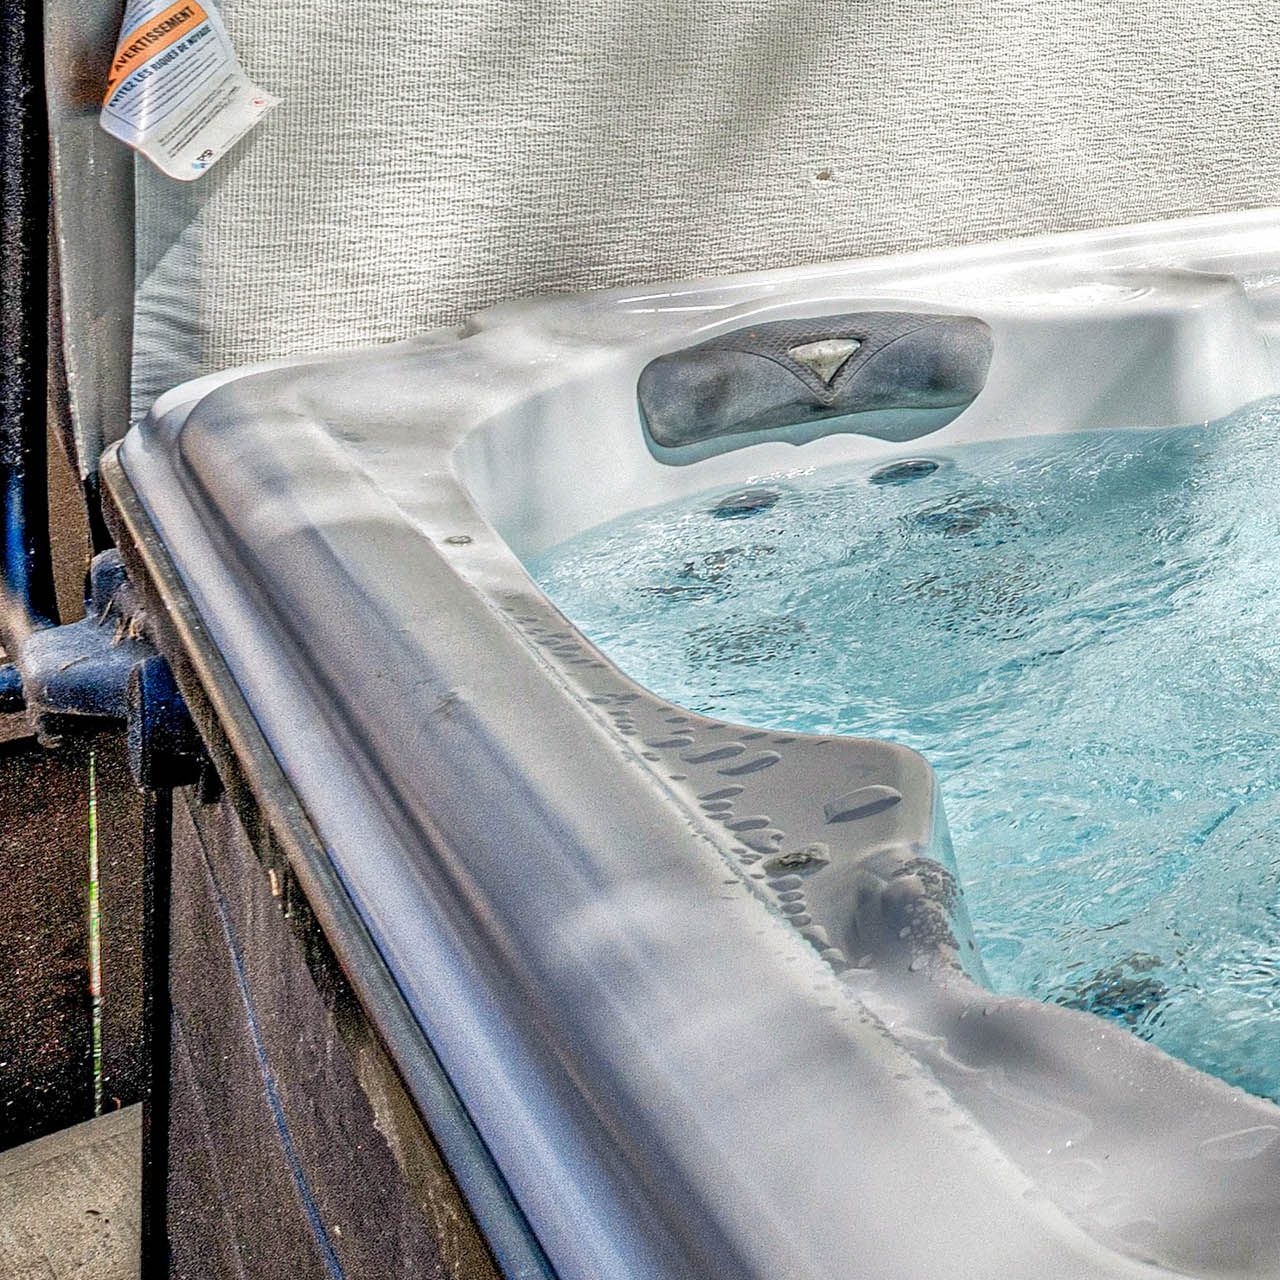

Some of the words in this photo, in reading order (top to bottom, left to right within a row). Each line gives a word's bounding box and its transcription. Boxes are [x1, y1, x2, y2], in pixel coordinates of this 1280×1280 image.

[114, 6, 195, 72] AVERTISSEMENT
[133, 68, 154, 83] LES
[176, 42, 190, 54] DE
